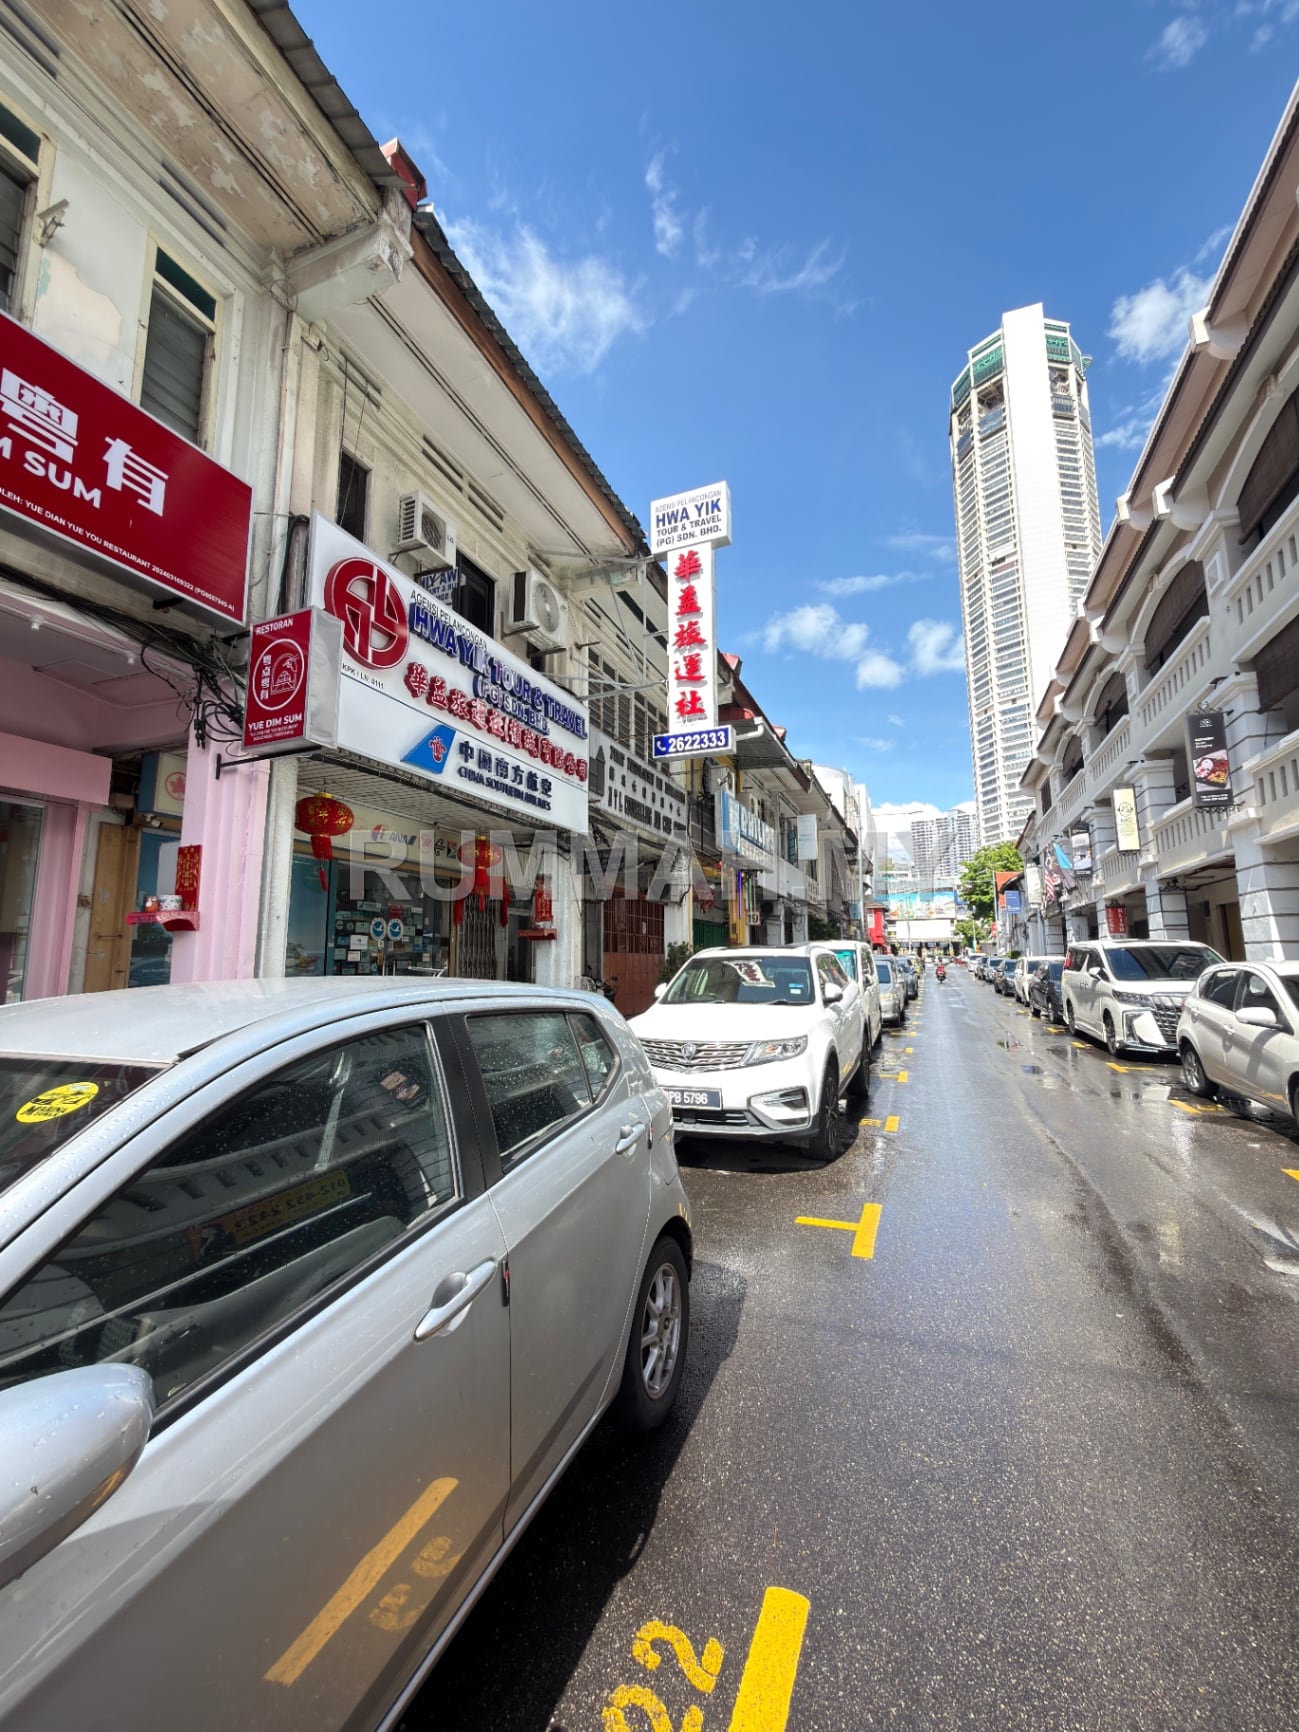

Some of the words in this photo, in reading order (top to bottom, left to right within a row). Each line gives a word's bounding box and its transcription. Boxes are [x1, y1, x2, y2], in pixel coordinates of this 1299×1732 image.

[23, 450, 102, 509] SUM
[655, 507, 690, 528] HWA
[694, 497, 722, 518] YIK
[657, 525, 679, 537] TOUR
[681, 522, 687, 532] &
[689, 514, 721, 529] TRAVEL
[0, 486, 23, 505] LEH:
[25, 499, 43, 515] YUE
[45, 510, 66, 526] DIAN
[67, 521, 84, 535] YUE
[85, 531, 102, 544] YOU
[103, 540, 151, 568] RESTAURANT
[656, 535, 675, 549] (PG)
[677, 530, 698, 542] SDN.
[700, 524, 722, 536] BHD.
[255, 617, 294, 636] RESTORAN
[410, 589, 439, 617] AGENSI
[439, 608, 489, 653] PELANCONGAN
[408, 602, 459, 659] HWA
[457, 634, 492, 678] YIK
[490, 656, 533, 705] TOUR
[532, 686, 544, 712] &
[541, 692, 588, 741] TRAVEL
[472, 673, 504, 711] (PG)
[502, 693, 528, 722] SDN.
[247, 720, 263, 731] YUE
[265, 717, 282, 729] DIM
[283, 712, 303, 725] SUM
[668, 730, 726, 753] 2622333
[683, 1091, 708, 1105] 5796
